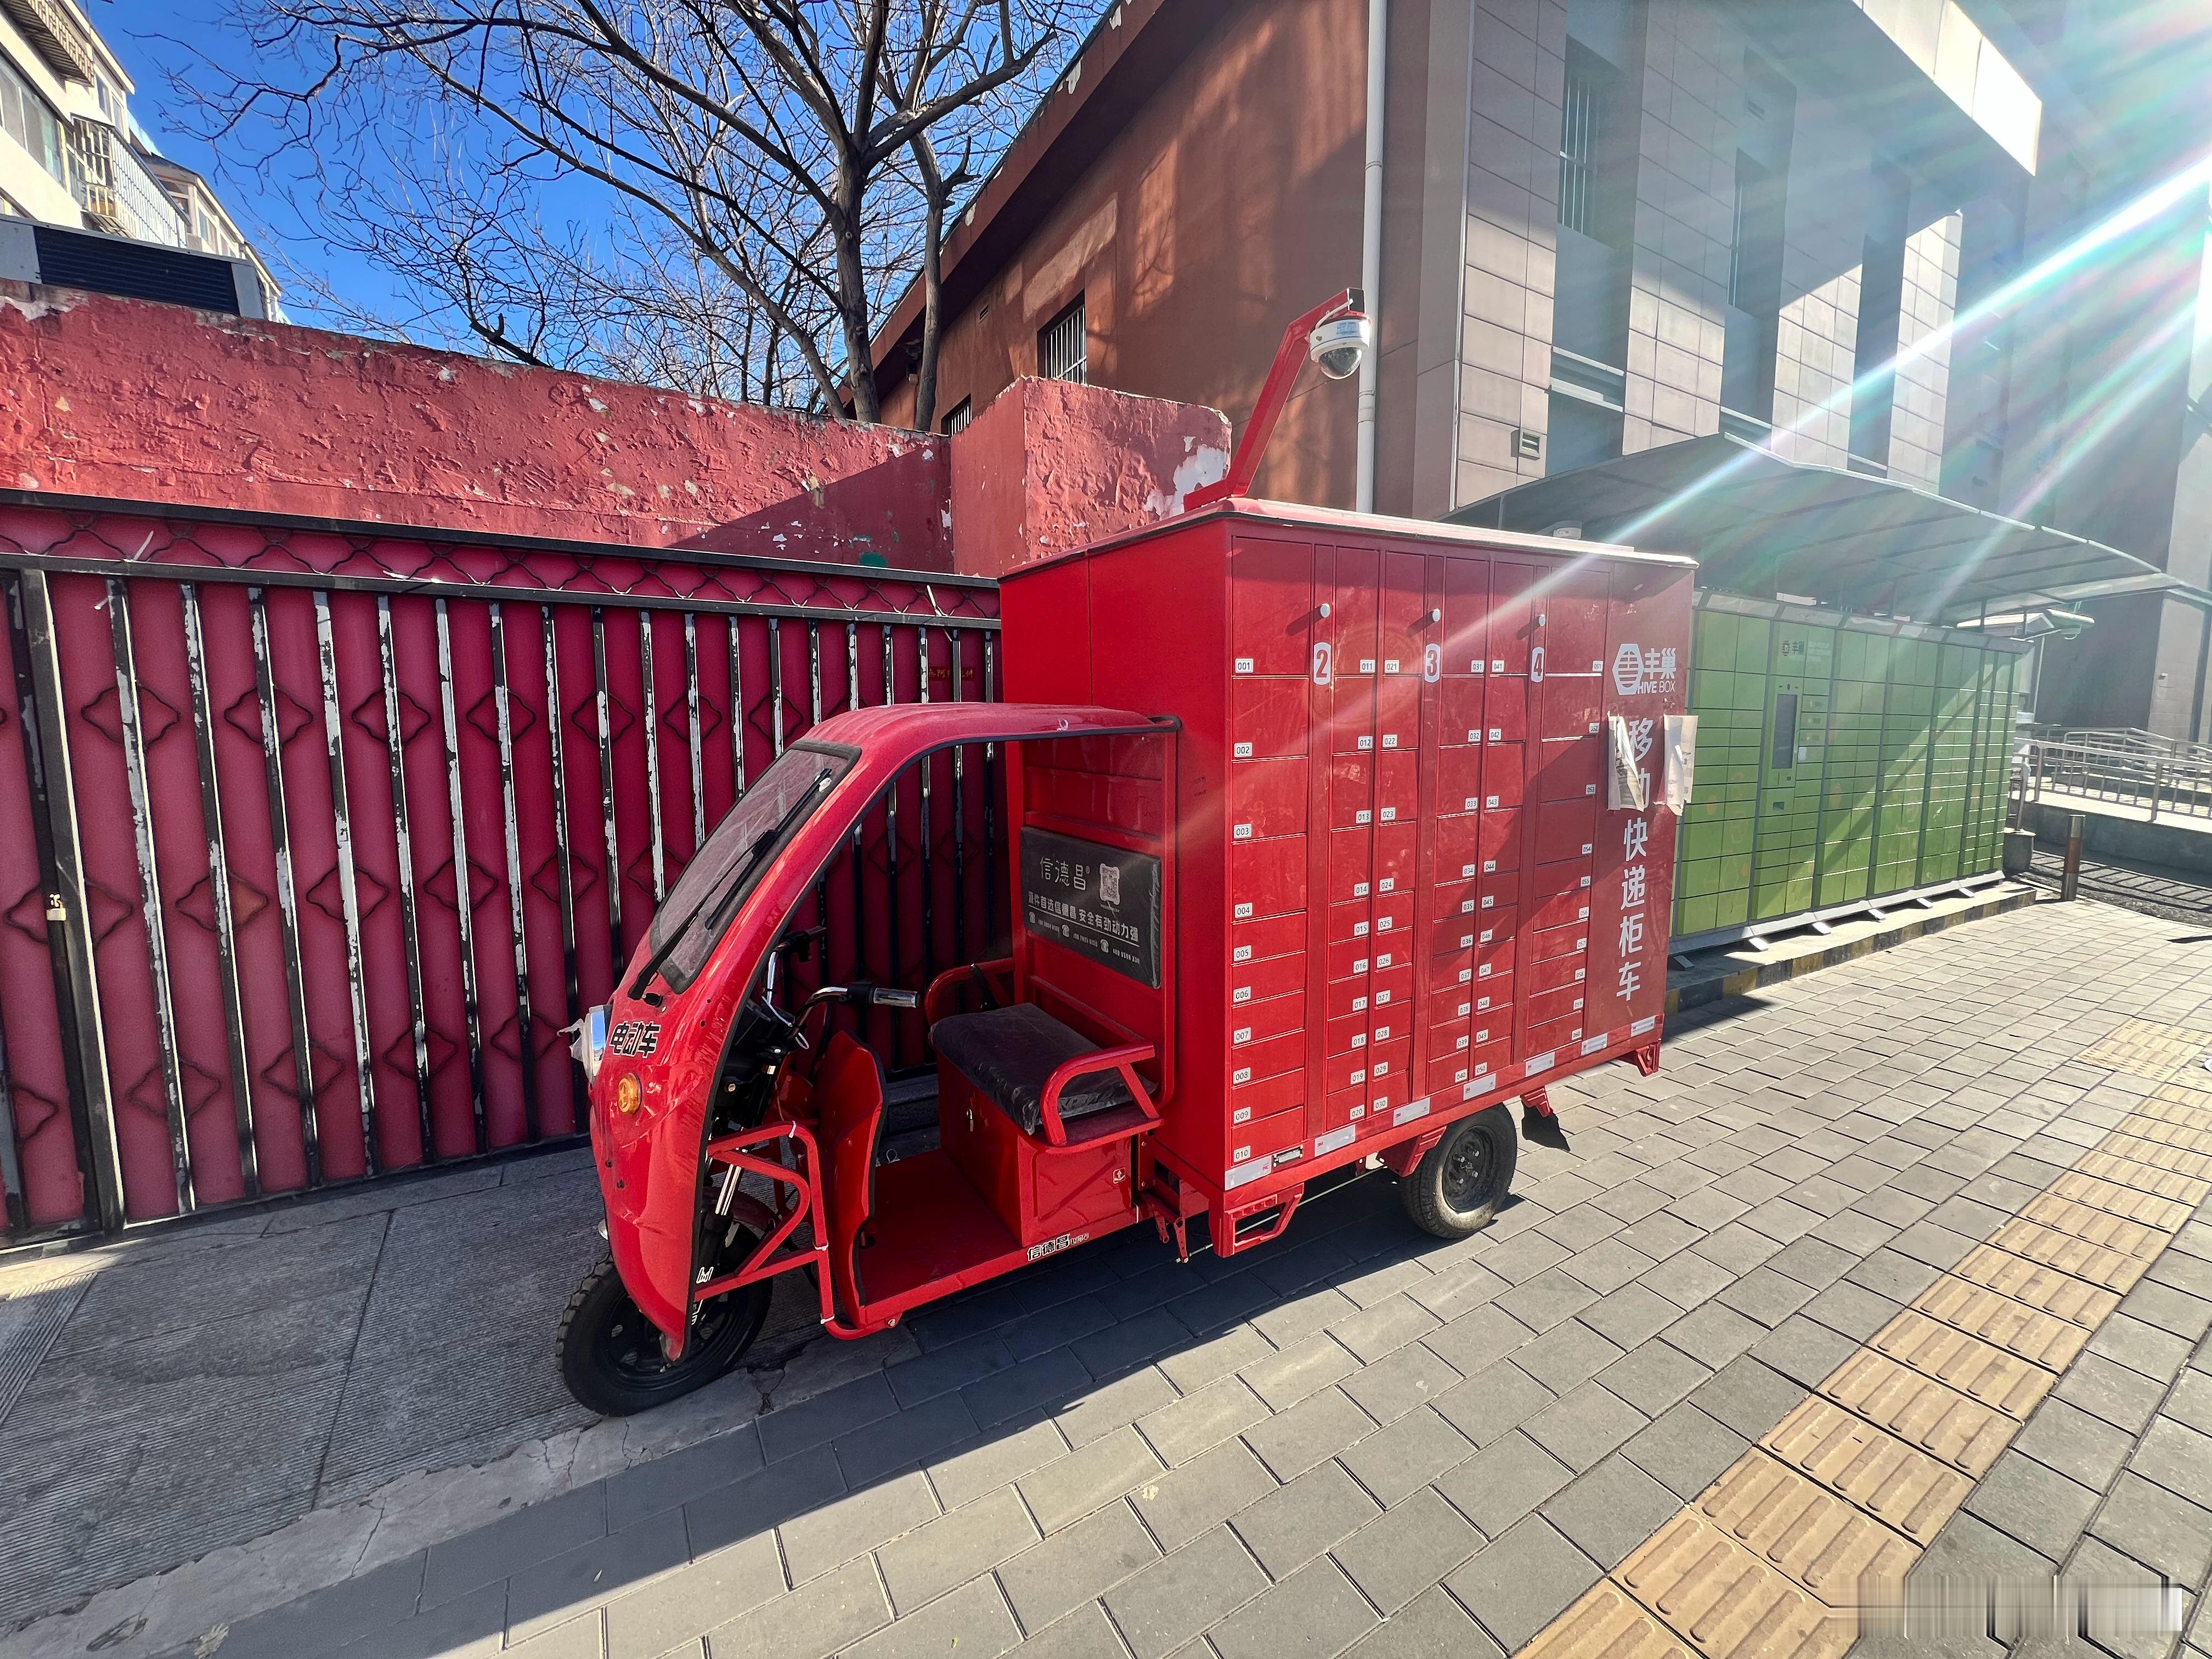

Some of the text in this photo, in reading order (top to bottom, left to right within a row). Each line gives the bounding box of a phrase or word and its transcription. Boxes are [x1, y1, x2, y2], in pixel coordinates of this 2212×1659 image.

[1238, 662, 1250, 670] 001
[1316, 649, 1328, 678] 2
[1362, 663, 1373, 672] 011
[1386, 663, 1398, 672] 021
[1427, 650, 1437, 677] 3
[1533, 651, 1543, 676] 4
[1644, 648, 1676, 680] 丰巢
[1638, 680, 1675, 693] HIVE BOX
[1359, 739, 1372, 748] 012
[1237, 746, 1250, 754] 002
[1358, 813, 1369, 822] 013
[1383, 810, 1393, 819] 023
[1236, 827, 1249, 836] 003
[1356, 885, 1367, 894] 014
[1381, 881, 1392, 889] 024
[1237, 906, 1250, 915] 004
[1379, 919, 1390, 928] 025
[1356, 925, 1367, 933] 015
[1236, 949, 1249, 958] 005
[1355, 962, 1366, 970] 016
[1379, 957, 1389, 966] 026
[1235, 990, 1249, 1000] 006
[1378, 993, 1389, 1002] 027
[1355, 1000, 1365, 1008] 017
[1236, 1031, 1249, 1040] 007
[1377, 1029, 1387, 1038] 028
[609, 1020, 662, 1059] 电动车
[1353, 1036, 1364, 1046] 018
[1375, 1065, 1386, 1074] 029
[1235, 1071, 1248, 1081] 008
[1352, 1073, 1363, 1082] 019
[1375, 1100, 1386, 1109] 030
[1235, 1110, 1249, 1120] 009
[1352, 1108, 1363, 1117] 020
[1235, 1149, 1248, 1159] 010
[1027, 1233, 1070, 1261] 信德昌
